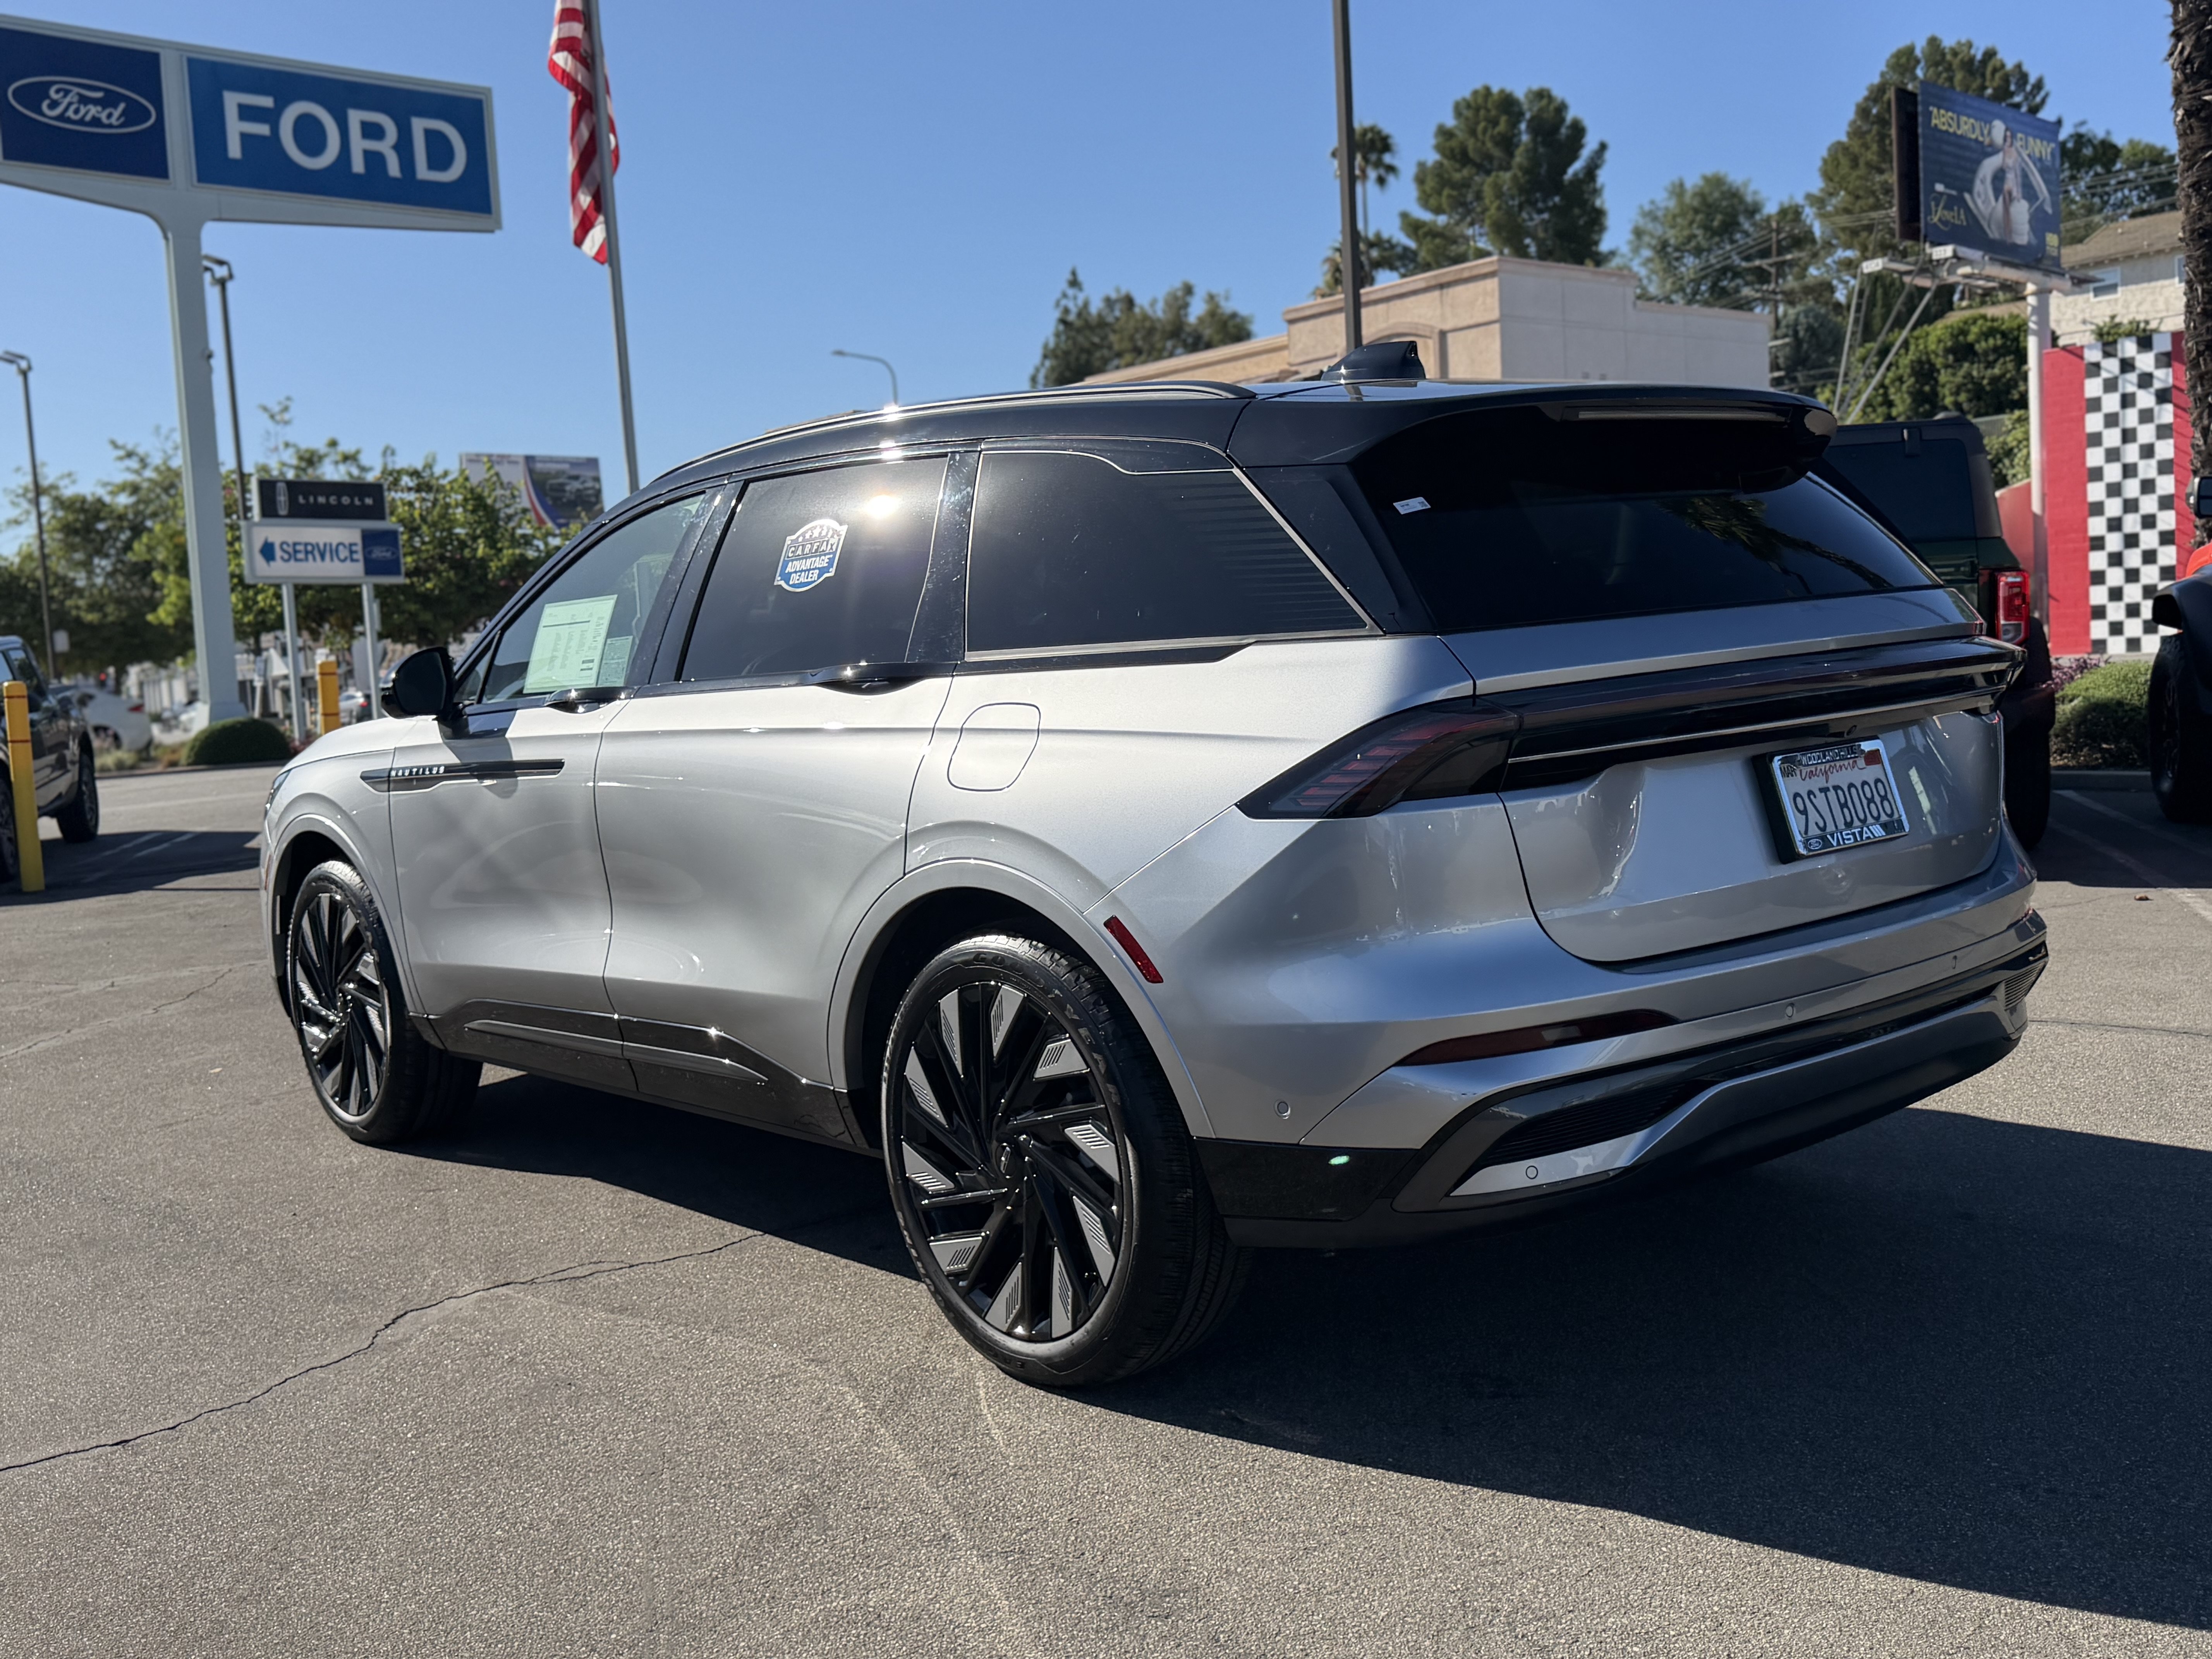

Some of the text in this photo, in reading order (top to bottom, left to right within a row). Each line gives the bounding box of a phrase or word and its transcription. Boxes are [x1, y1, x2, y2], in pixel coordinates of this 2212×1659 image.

[41, 83, 126, 126] Ford
[223, 90, 467, 183] FORD
[298, 495, 374, 505] LINCOLN
[279, 541, 361, 563] SERVICE
[788, 540, 836, 557] CARFAX
[785, 555, 830, 573] ADVANTAGE
[789, 570, 819, 584] DEALER
[1800, 749, 1839, 765] WOODLAND
[390, 766, 445, 777] NAUTILUS
[1799, 758, 1867, 783] California
[1793, 778, 1894, 835] 9STB088
[1827, 826, 1874, 847] VISTA
[973, 952, 1121, 1105] GOODYEAR
